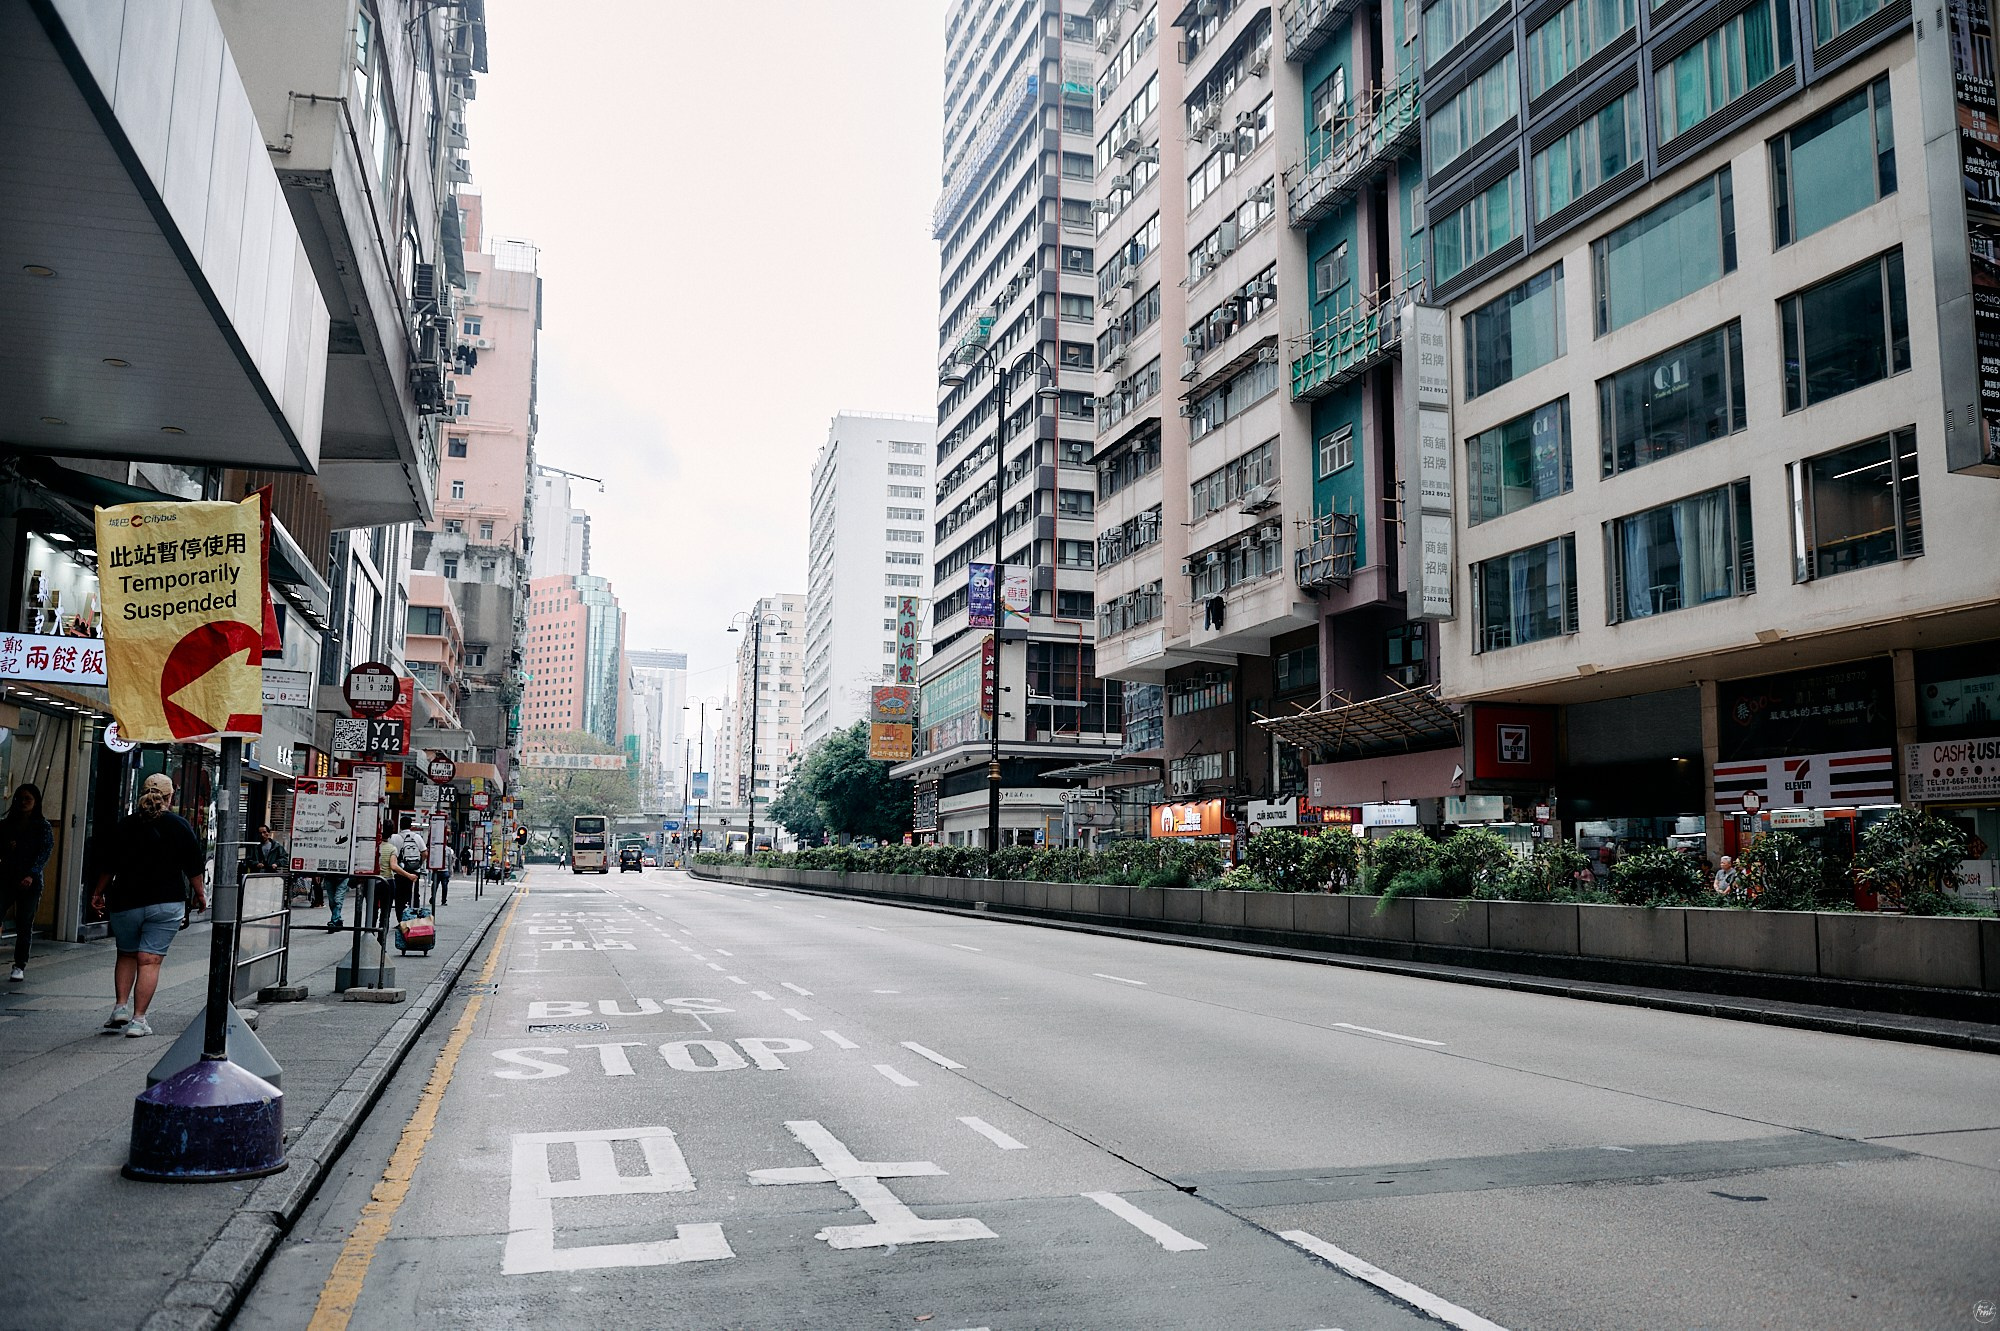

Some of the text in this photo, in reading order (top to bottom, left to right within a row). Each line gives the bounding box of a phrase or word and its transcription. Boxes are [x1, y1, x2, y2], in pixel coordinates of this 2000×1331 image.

[1956, 73, 1994, 87] DAYPASS
[1964, 84, 1987, 95] $98/日
[1973, 121, 1987, 130] 日租
[1965, 164, 1983, 174] 5965
[1421, 352, 1444, 367] 招牌
[1654, 360, 1680, 389] Q1
[1981, 365, 1998, 374] 5965
[1982, 389, 2000, 398] 6889
[1533, 417, 1548, 436] Q1
[1423, 456, 1447, 470] 招牌
[108, 513, 177, 528] 城巴 Citybus
[109, 533, 246, 569] 此站暫停使用
[1426, 561, 1448, 575] 招牌
[119, 563, 241, 594] Temporarily
[974, 576, 990, 588] 50
[1008, 587, 1028, 598] 香港
[123, 590, 238, 621] Suspended
[900, 598, 916, 682] 花園酒家
[26, 646, 104, 676] 兩餸飯
[373, 722, 399, 736] YT
[371, 737, 400, 751] 542
[1934, 744, 1966, 763] CASH
[1785, 780, 1811, 790] ELEVEN
[1267, 810, 1287, 820] BOUTIQUE
[1036, 831, 1044, 840] P
[1964, 874, 1977, 884] CASH
[527, 997, 736, 1018] BUS
[492, 1038, 813, 1080] STOP
[501, 1120, 999, 1275] 巴士
